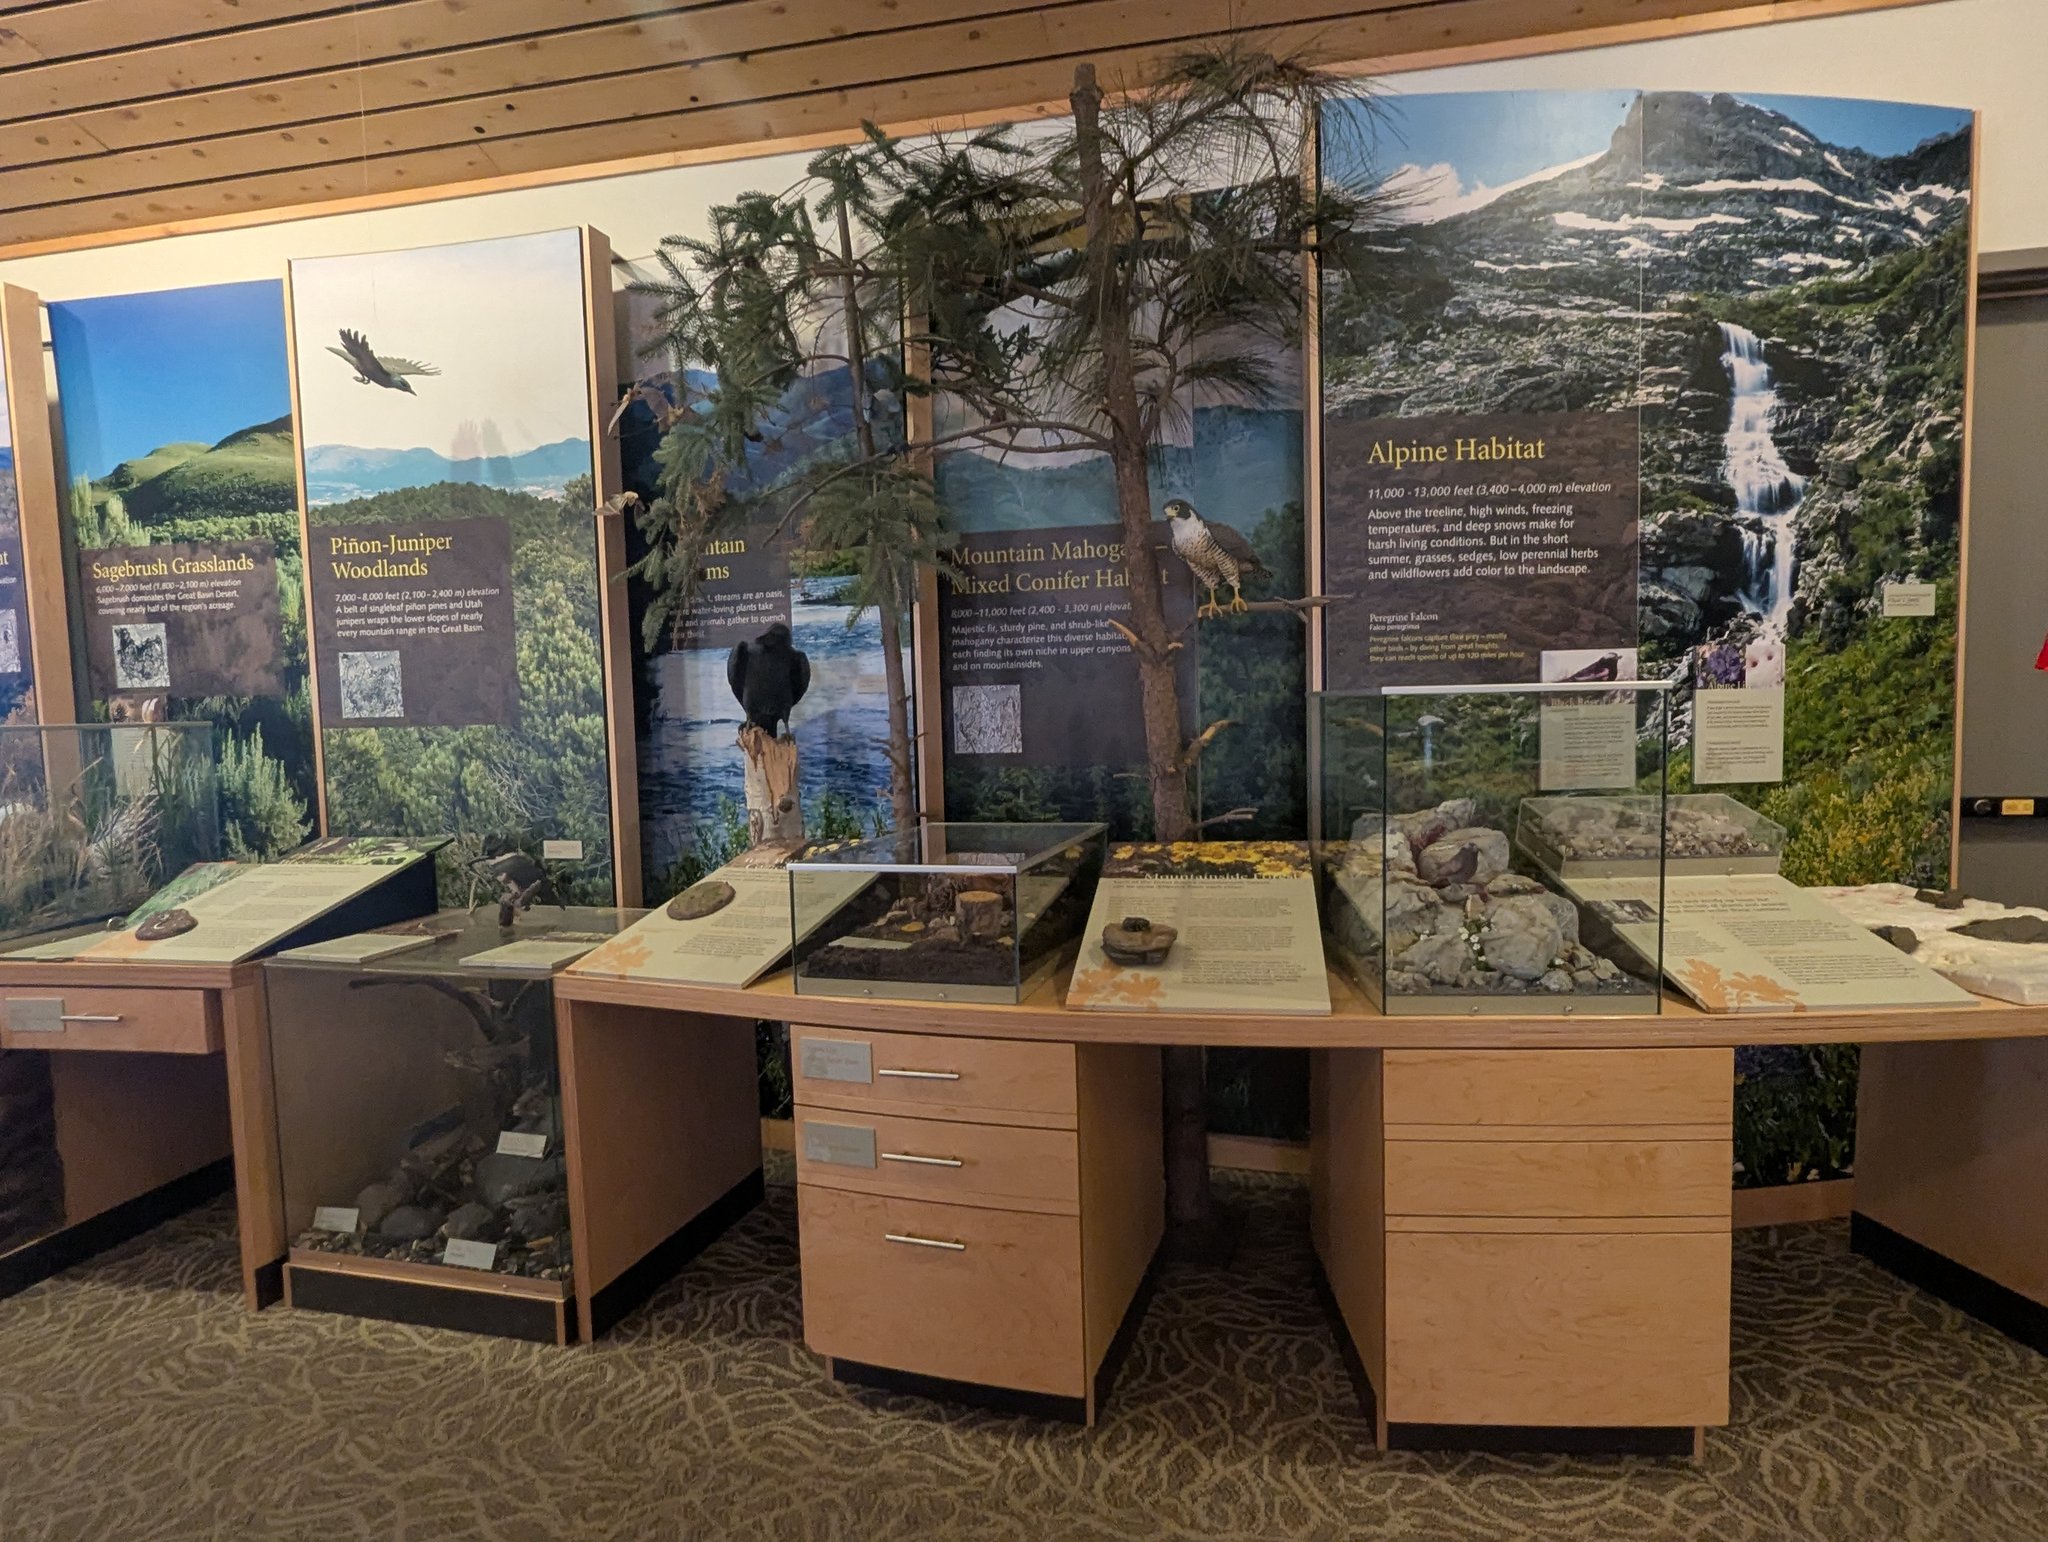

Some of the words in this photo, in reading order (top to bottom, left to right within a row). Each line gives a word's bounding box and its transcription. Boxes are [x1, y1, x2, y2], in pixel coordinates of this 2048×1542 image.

[1367, 440, 1448, 470] Alpine
[1455, 436, 1545, 461] Habitat
[1368, 488, 1405, 499] 11,000
[1413, 486, 1450, 498] 13,000
[1454, 486, 1474, 496] feet
[1549, 483, 1563, 495] m)
[1566, 482, 1611, 493] elevation
[1368, 508, 1401, 519] Above
[1404, 507, 1422, 518] the
[1425, 506, 1466, 518] treeline,
[1470, 504, 1492, 519] high
[1496, 504, 1529, 516] winds,
[1532, 502, 1573, 516] freezing
[1368, 522, 1439, 536] temperatures,
[1443, 521, 1462, 532] and
[1465, 520, 1491, 533] deep
[1494, 522, 1526, 530] snows
[1529, 518, 1557, 529] make
[1560, 517, 1575, 528] for
[331, 534, 453, 557] Piñon-Juniper
[1368, 538, 1396, 549] harsh
[1399, 537, 1428, 551] living
[1430, 536, 1486, 547] conditions.
[1490, 534, 1507, 546] But
[1510, 534, 1520, 545] in
[1523, 534, 1540, 544] the
[1542, 532, 1569, 544] short
[951, 543, 1045, 564] Mountain
[1368, 555, 1412, 565] summer,
[1414, 554, 1455, 566] grasses,
[1458, 551, 1496, 564] sedges,
[1499, 550, 1518, 560] low
[1521, 548, 1568, 562] perennial
[1571, 547, 1599, 558] herbs
[93, 558, 169, 582] Sagebrush
[172, 554, 254, 574] Grasslands
[332, 558, 428, 579] Woodlands
[1368, 569, 1388, 579] and
[1391, 568, 1450, 578] wildflowers
[1453, 566, 1472, 576] add
[1476, 566, 1501, 576] color
[1504, 565, 1515, 575] to
[1518, 564, 1535, 574] the
[1537, 563, 1590, 576] landscape.
[199, 580, 209, 588] m)
[210, 579, 241, 587] elevation
[952, 574, 1010, 594] Mixed
[1016, 571, 1090, 591] Conifer
[96, 595, 130, 605] Sagebrush
[454, 589, 465, 597] m)
[467, 588, 500, 596] elevation
[98, 606, 125, 615] covering
[127, 605, 146, 614] nearly
[370, 603, 404, 614] singleleaf
[428, 602, 447, 612] pines
[736, 604, 757, 614] plants
[1009, 607, 1025, 615] feet
[1028, 606, 1056, 615] (2,400
[1064, 604, 1089, 613] 3,300
[1091, 603, 1102, 612] m)
[337, 617, 366, 627] junipers
[367, 617, 389, 626] wraps
[427, 614, 449, 624] slopes
[461, 612, 483, 622] nearly
[727, 616, 750, 626] gather
[760, 614, 786, 624] quench
[1370, 613, 1408, 623] Peregrine
[1410, 612, 1439, 621] Falcon
[337, 630, 357, 638] every
[359, 627, 394, 636] mountain
[396, 628, 416, 636] range
[441, 624, 462, 633] Great
[464, 624, 484, 632] Basin.
[952, 624, 986, 636] Majestic
[987, 624, 998, 633] fir,
[1000, 623, 1026, 633] sturdy
[1050, 621, 1066, 629] and
[952, 637, 995, 647] mahogany
[996, 635, 1045, 644] characterize
[952, 650, 971, 659] each
[974, 649, 1002, 659] finding
[1036, 647, 1058, 655] niche
[1070, 647, 1094, 656] upper
[1096, 645, 1131, 654] canyons
[983, 660, 1043, 669] mountainsides.
